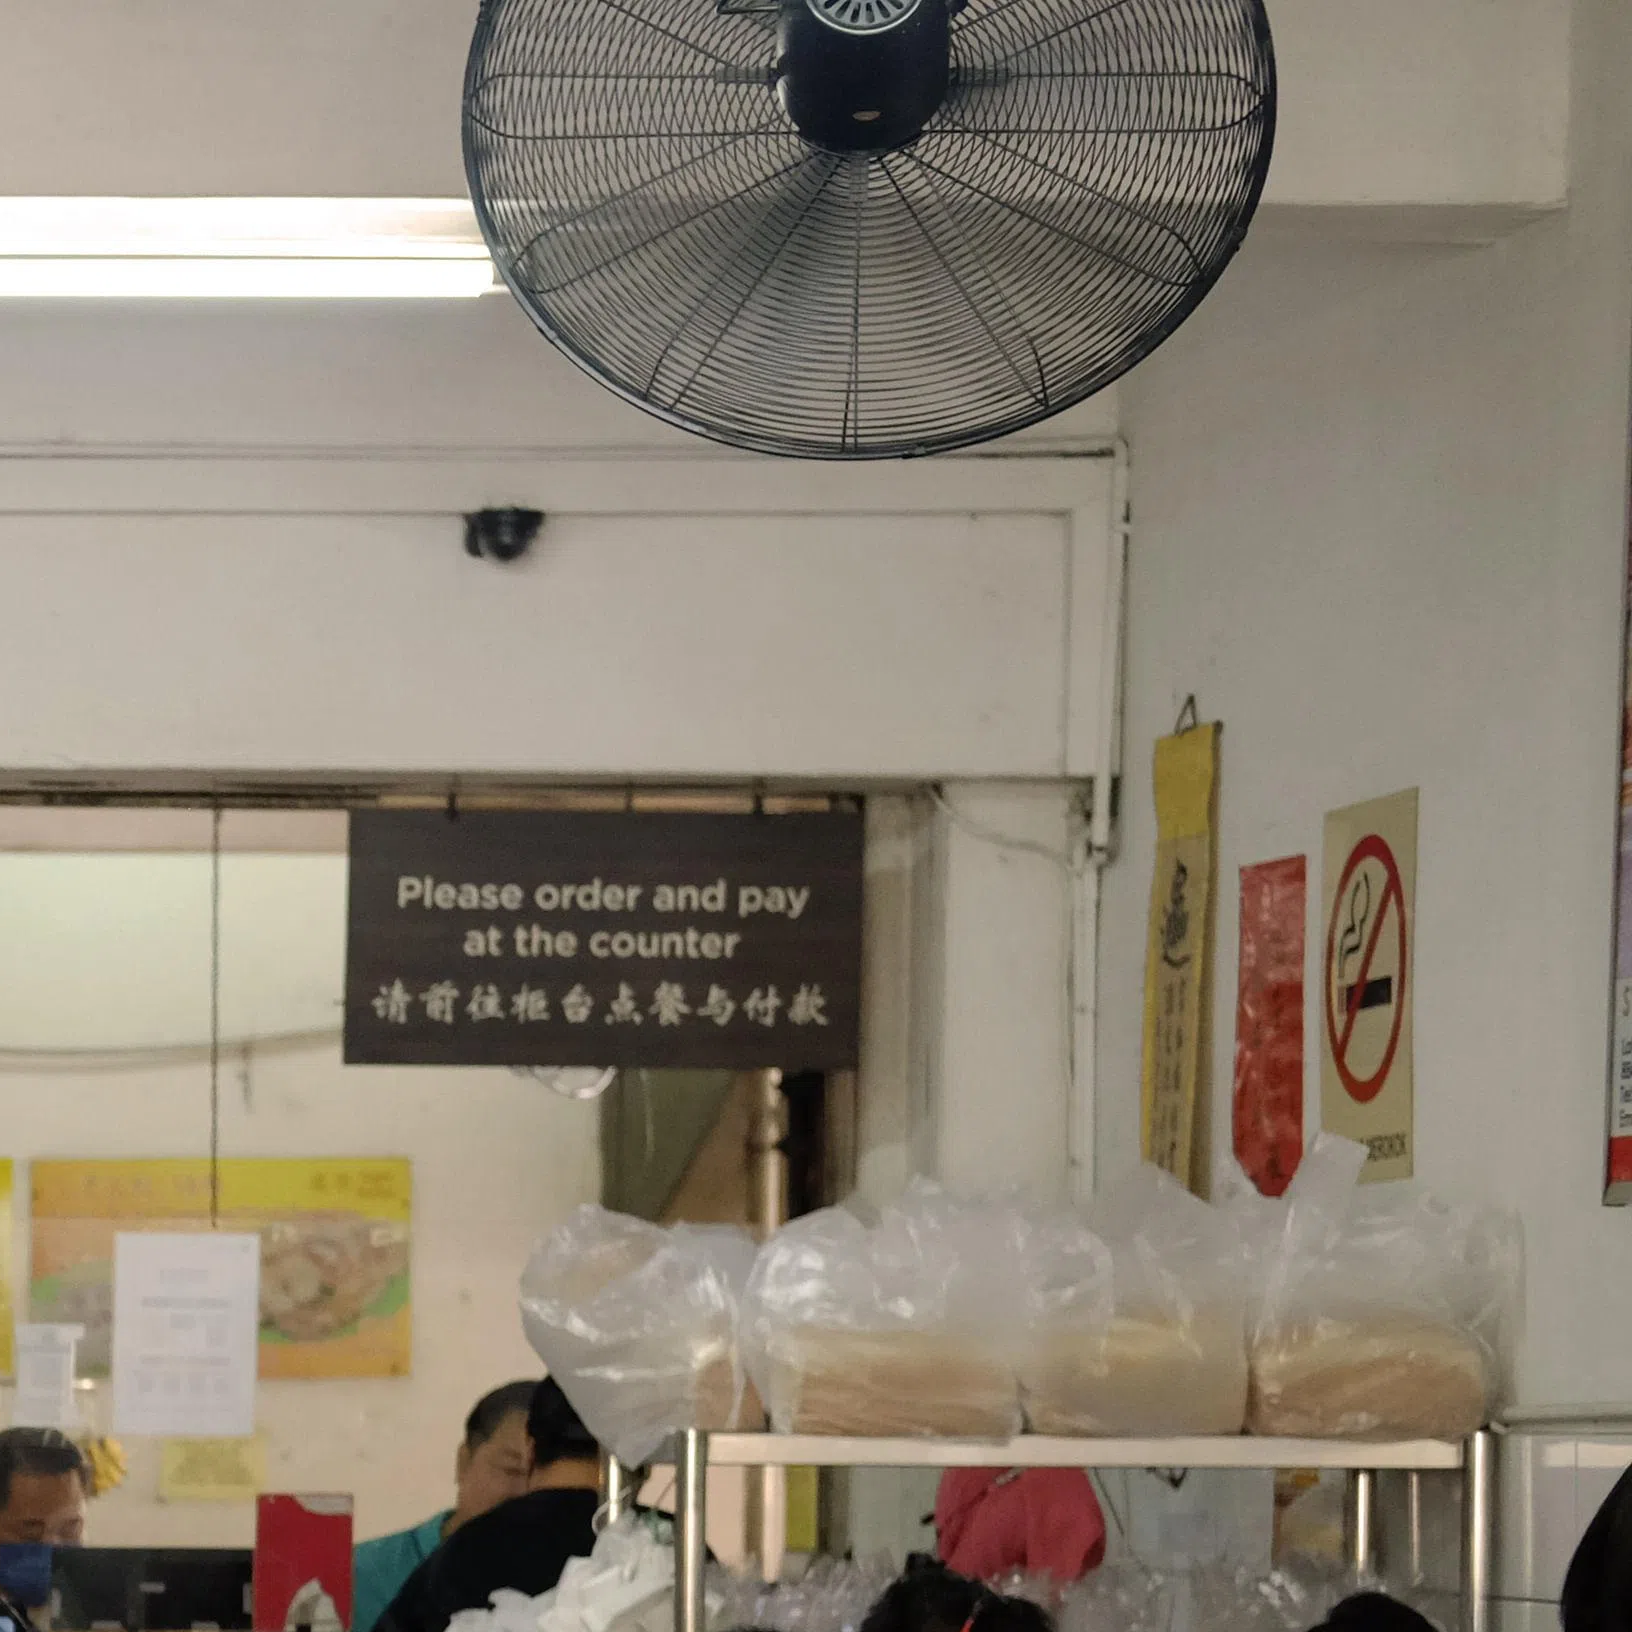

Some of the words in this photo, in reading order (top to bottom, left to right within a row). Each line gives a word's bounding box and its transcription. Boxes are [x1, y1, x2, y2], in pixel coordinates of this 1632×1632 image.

[397, 875, 523, 910] Please
[535, 877, 642, 912] order
[653, 878, 727, 913] and
[739, 883, 810, 919] pay
[463, 926, 502, 957] at
[514, 924, 577, 957] the
[589, 929, 741, 959] counter
